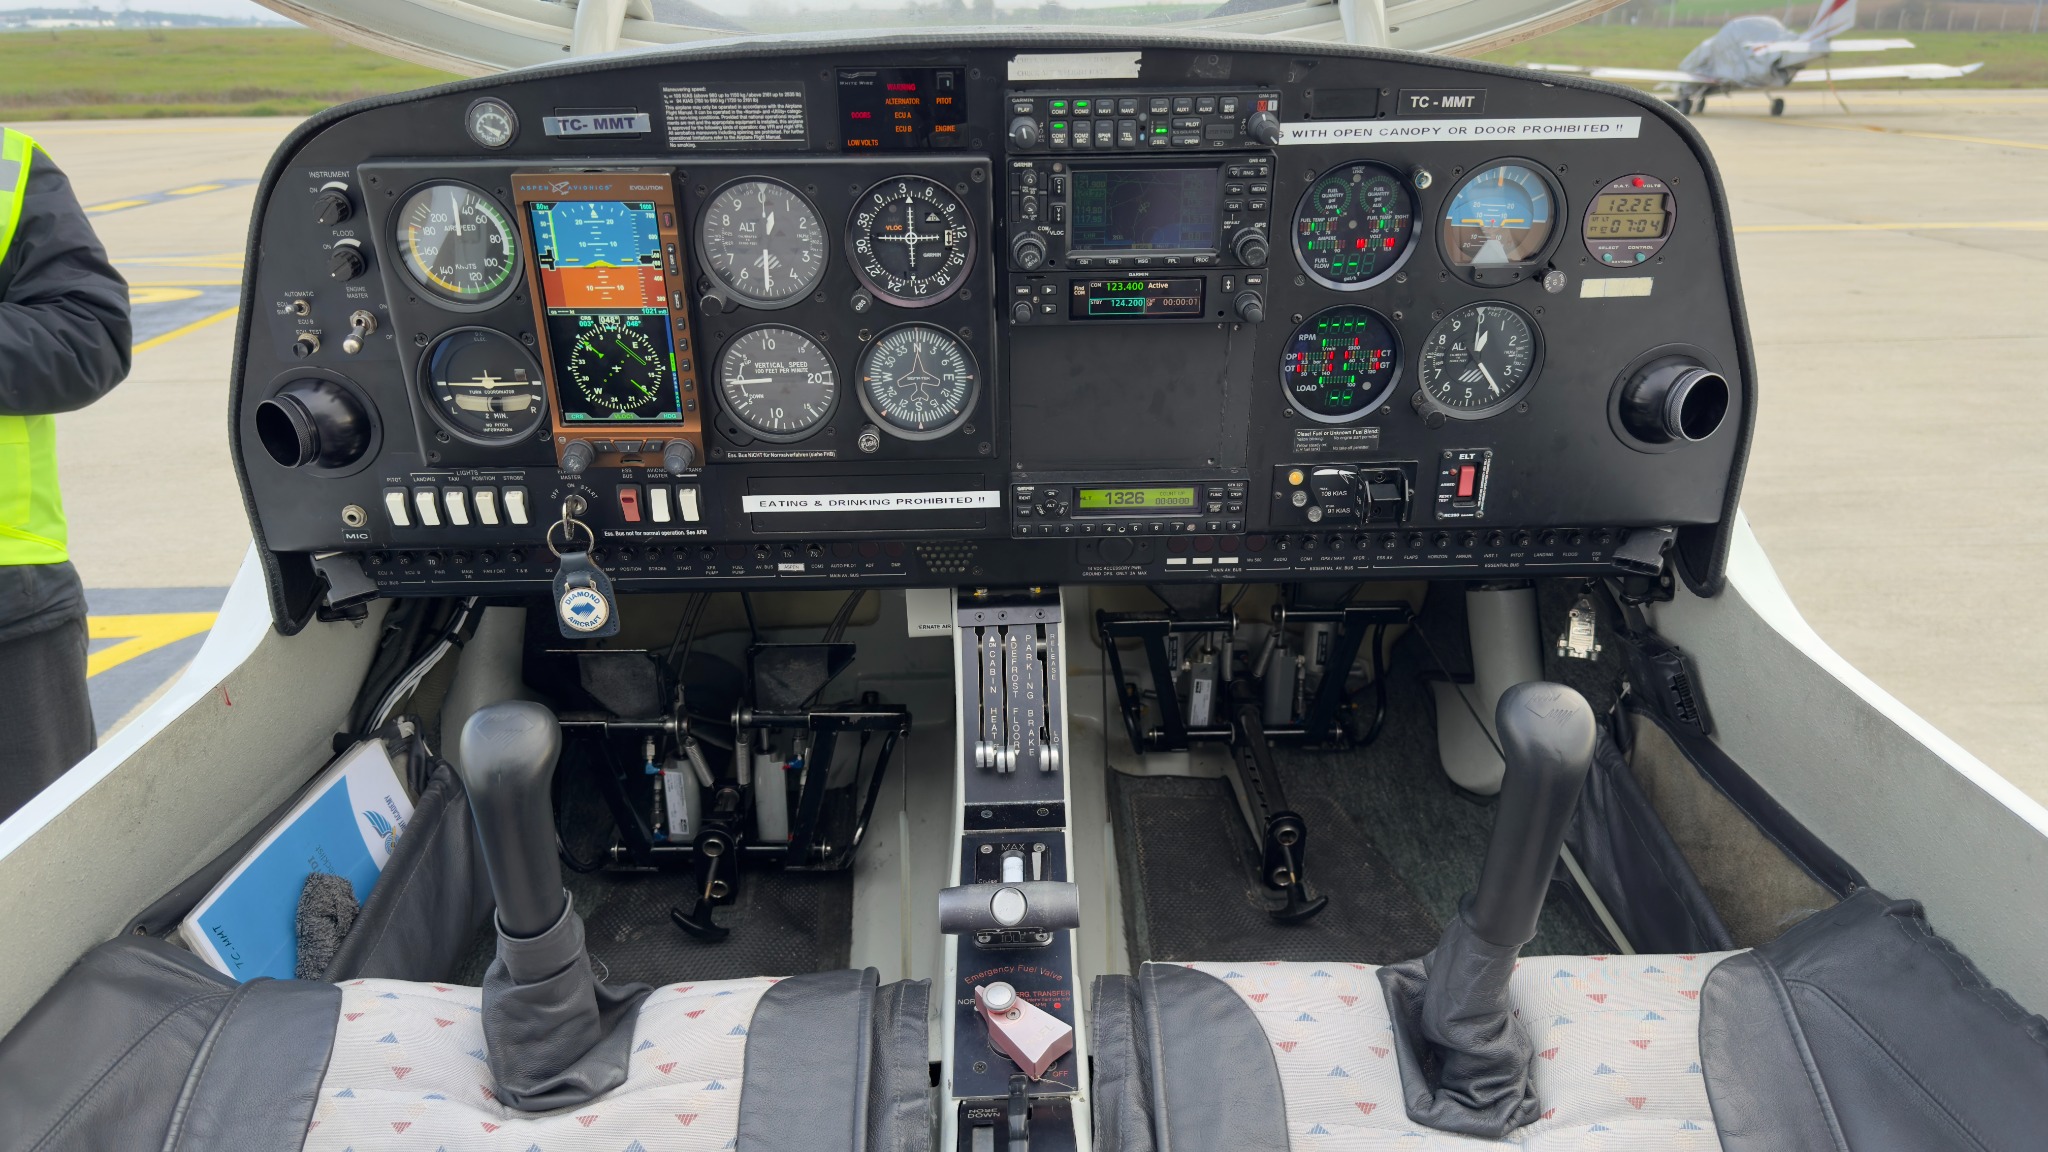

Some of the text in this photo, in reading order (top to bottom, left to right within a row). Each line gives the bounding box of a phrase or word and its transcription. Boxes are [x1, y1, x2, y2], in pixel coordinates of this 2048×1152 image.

[936, 97, 952, 105] PITOT
[1410, 96, 1430, 108] TC
[1441, 95, 1476, 108] MMT
[594, 117, 635, 130] MMT
[1291, 129, 1328, 138] WITH
[1333, 128, 1373, 137] OPEN
[1379, 126, 1442, 136] CANOPY
[1448, 126, 1468, 135] OR
[1474, 125, 1517, 135] DOOR
[1522, 123, 1611, 134] PROHIBITED
[1615, 123, 1624, 132] !!
[848, 139, 860, 147] LOW
[462, 206, 474, 216] 40
[430, 213, 448, 223] 200
[475, 215, 488, 224] 60
[422, 226, 436, 236] 180
[739, 222, 756, 232] ALT
[490, 235, 501, 243] 80
[424, 246, 439, 256] 160
[484, 258, 498, 267] 100
[440, 266, 454, 275] 140
[469, 272, 483, 281] 120
[1105, 282, 1144, 291] 123.400
[1111, 299, 1144, 307] 124.200
[762, 338, 776, 350] 10
[1380, 361, 1391, 369] GT
[807, 373, 822, 384] 20
[1296, 384, 1317, 392] LOAD
[770, 407, 784, 419] 10
[759, 499, 808, 507] EATING
[828, 498, 891, 506] DRINKING
[896, 496, 973, 505] PROHIBITED
[1104, 491, 1145, 505] 1326
[1155, 497, 1190, 505] 00:00:00
[564, 591, 602, 628] DIAMOND AIRCRAFT
[989, 650, 997, 694] CABIN
[1010, 641, 1021, 748] DEFROST FLOOR
[1025, 634, 1035, 757] PARKING BRAKE
[990, 707, 998, 740] HEAT
[383, 794, 402, 823] ACADEMY
[1001, 843, 1025, 851] MAX
[1001, 933, 1026, 943] IDLE
[964, 964, 1063, 985] Emergency Fuel Valve
[1015, 990, 1032, 998] ERG.
[1052, 1070, 1069, 1078] OFF
